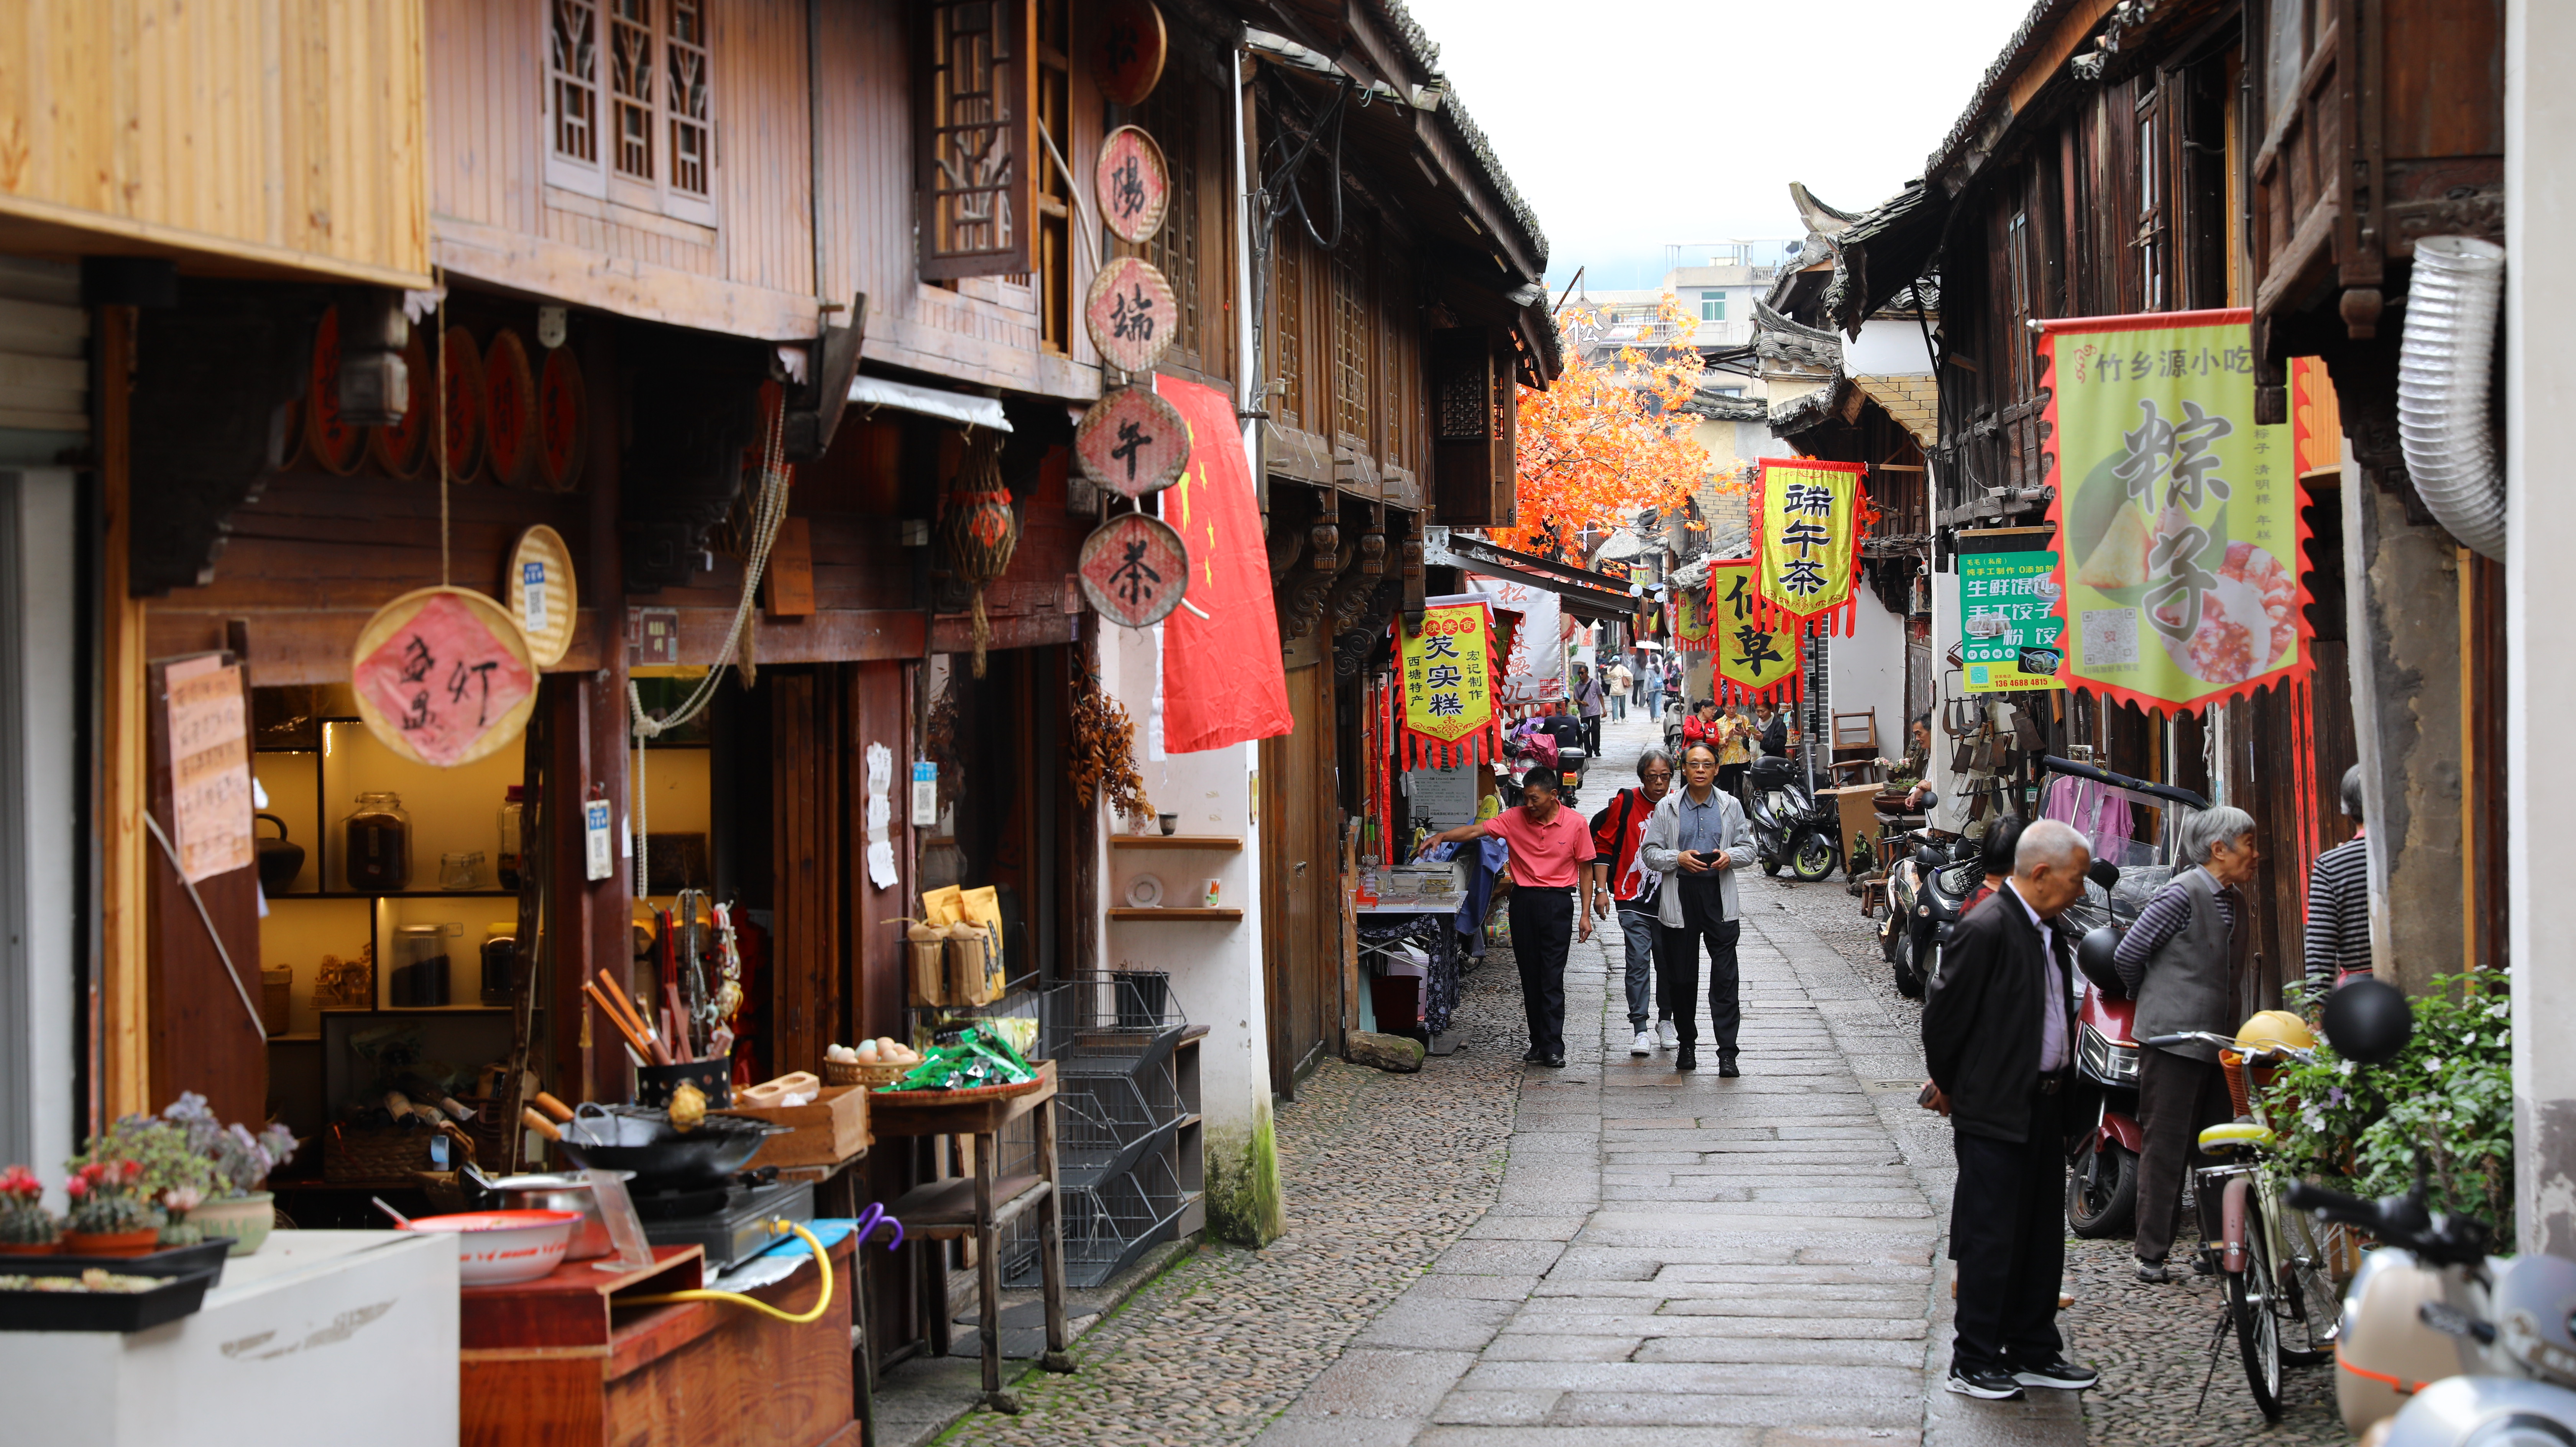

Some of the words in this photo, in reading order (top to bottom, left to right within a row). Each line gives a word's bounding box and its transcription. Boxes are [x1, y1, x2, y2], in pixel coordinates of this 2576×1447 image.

[2095, 345, 2253, 383] 竹乡源小吃
[1779, 484, 1835, 596] 端午茶
[2113, 399, 2233, 642] 粽子
[1967, 567, 2015, 576] 纯手工制作
[2019, 564, 2054, 574] 0添加剂
[1967, 577, 2054, 597] 生鲜馄饨
[1725, 575, 1784, 677] 仙草
[1968, 602, 2055, 622] 手工饺子
[1968, 650, 2014, 659] 口口鲜香
[1969, 627, 2057, 648] 三粉饺
[1406, 656, 1424, 707] 西塘特产
[1425, 635, 1464, 716] 芡实糕
[1466, 650, 1483, 701] 宏记制作
